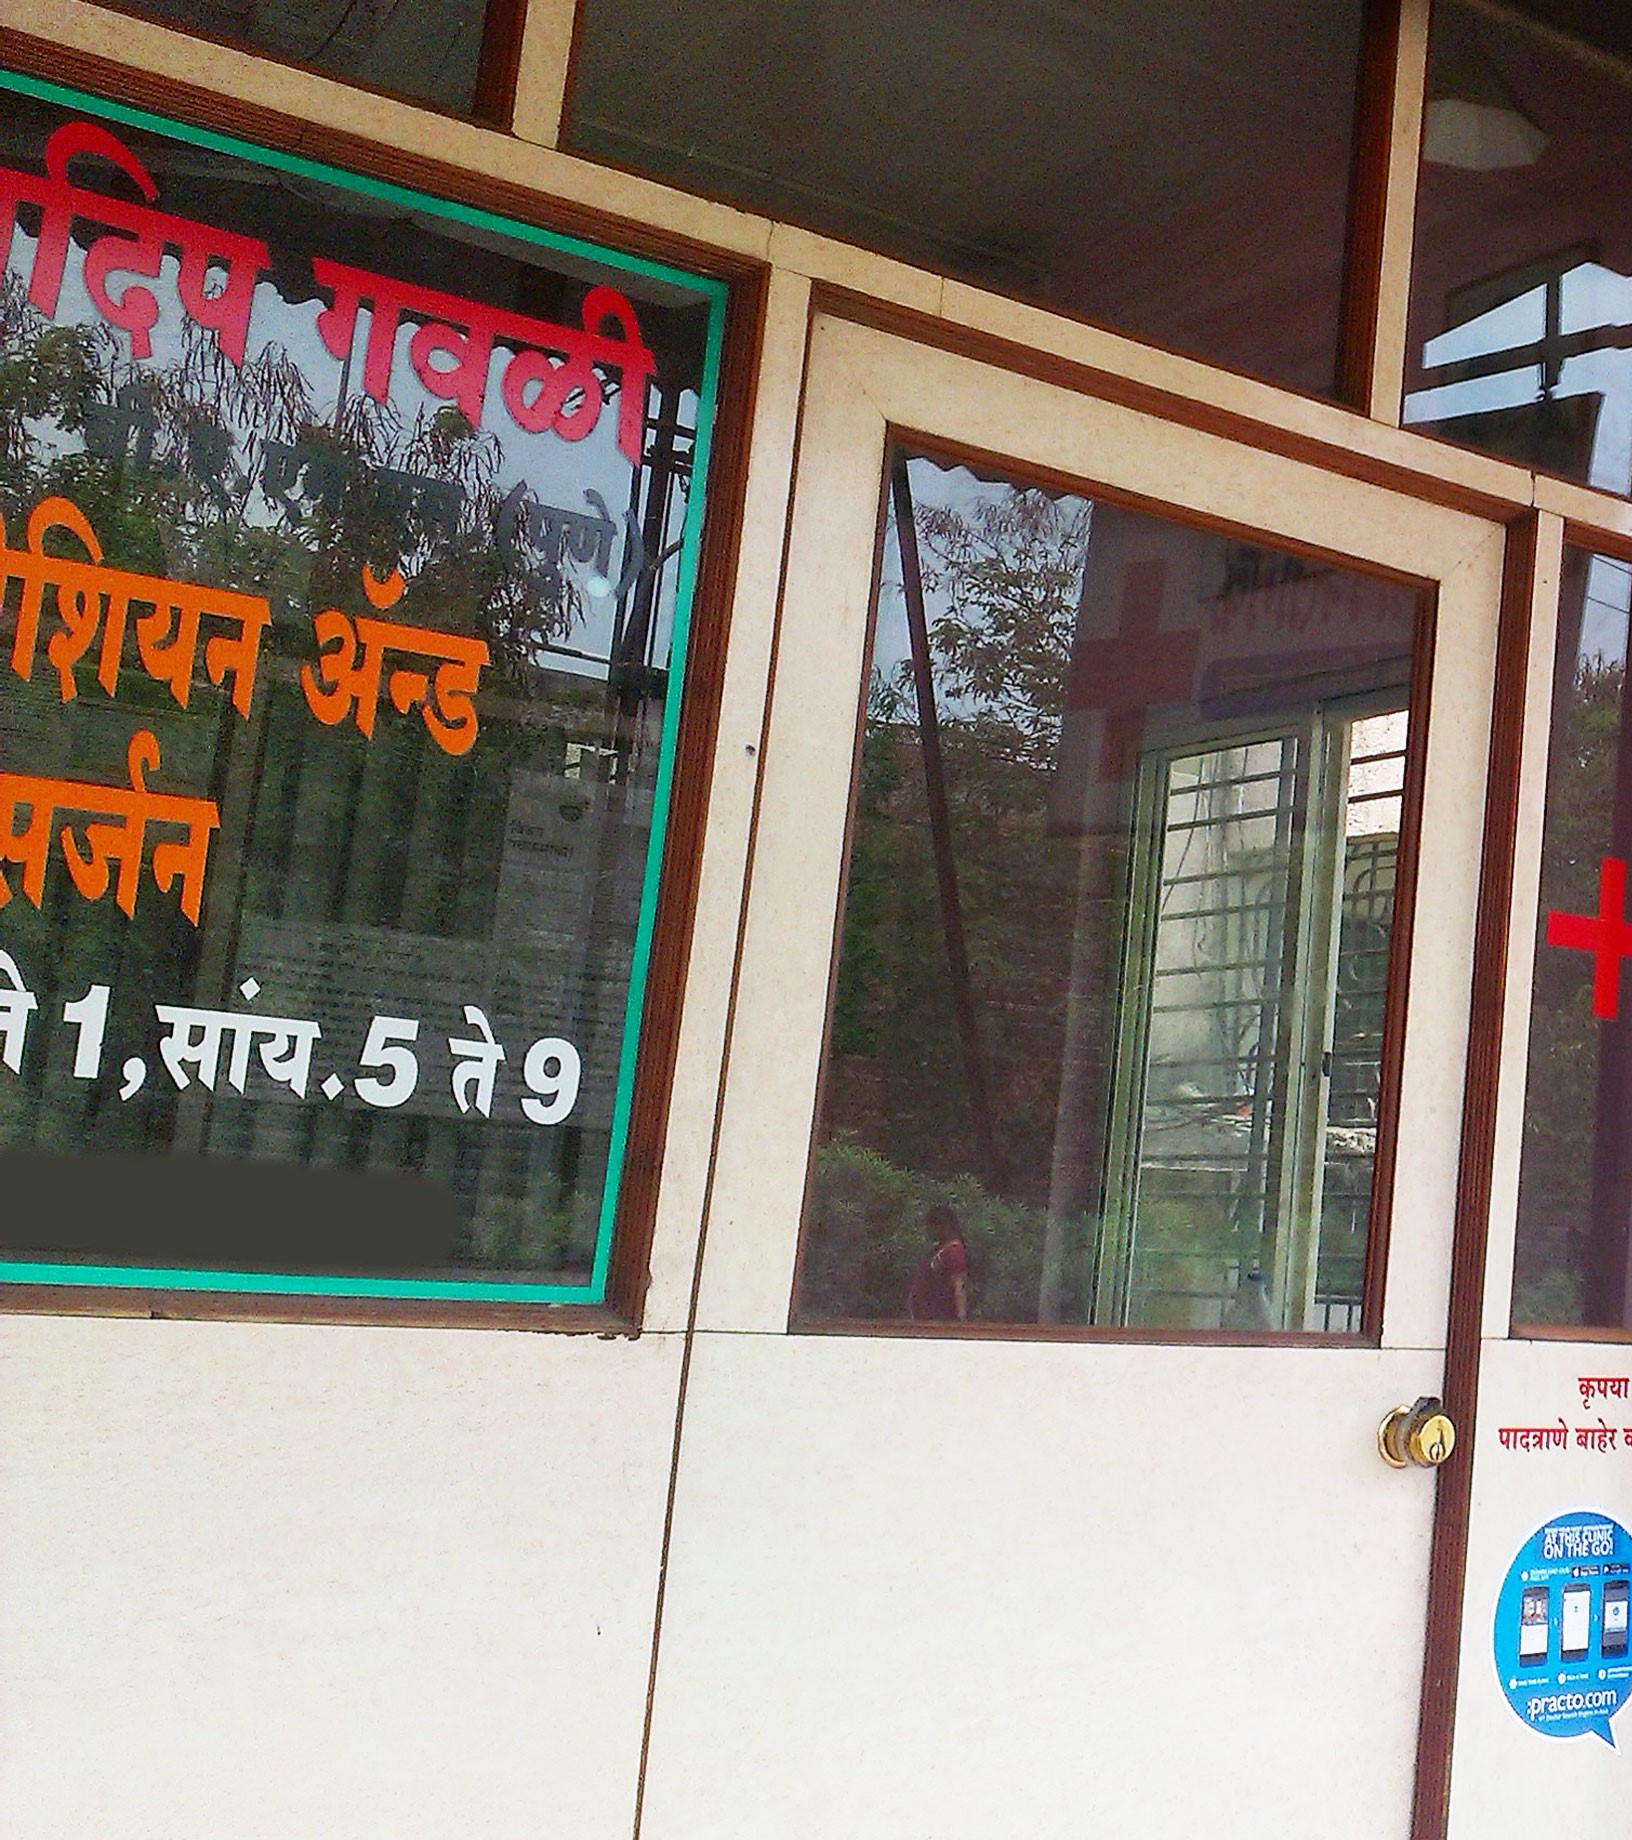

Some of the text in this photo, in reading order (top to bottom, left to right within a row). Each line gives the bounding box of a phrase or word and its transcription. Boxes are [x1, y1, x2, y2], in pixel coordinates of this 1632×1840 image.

[0, 121, 271, 369] दिप
[310, 255, 657, 469] गवळी
[0, 495, 273, 721] शियन
[0, 729, 220, 928] सर्जन
[448, 1005, 507, 1118] ते
[520, 1037, 582, 1126] 9
[1498, 1417, 1569, 1453] पादत्राणे
[1575, 1417, 1618, 1453] बाहेर
[1577, 1377, 1630, 1410] कृपया
[1543, 1539, 1614, 1560] ON THE GO!
